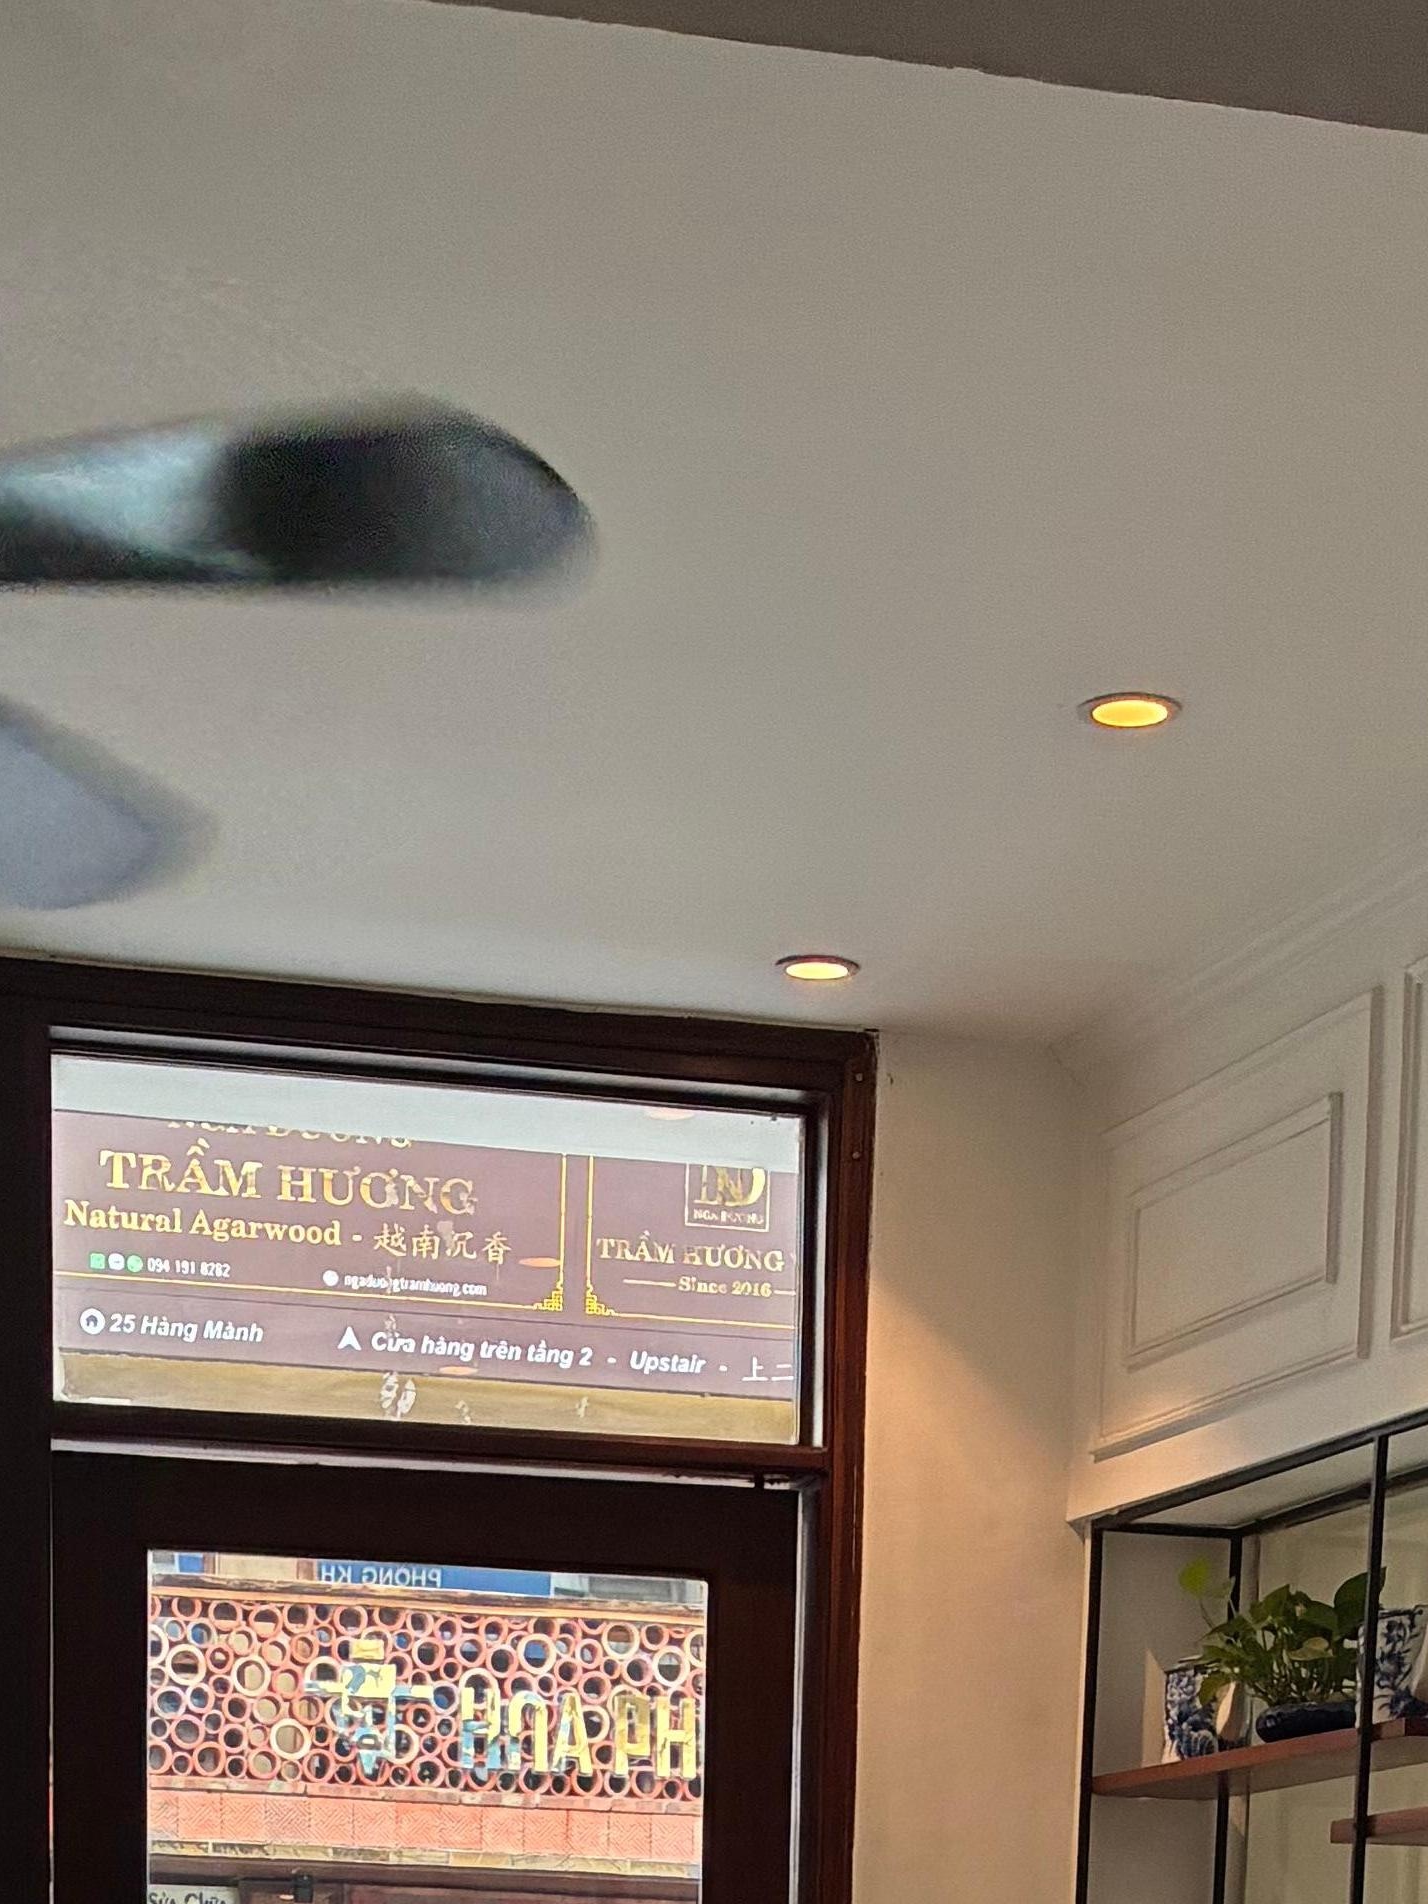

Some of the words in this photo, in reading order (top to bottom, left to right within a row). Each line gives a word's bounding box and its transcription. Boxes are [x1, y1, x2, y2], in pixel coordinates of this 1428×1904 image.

[99, 1137, 263, 1200] TRẦM
[277, 1164, 478, 1217] HƯƠNG
[63, 1199, 182, 1235] Natural
[189, 1209, 341, 1247] Agarwood
[596, 1231, 675, 1265] TRẦM
[678, 1276, 727, 1294] Since
[108, 1313, 136, 1335] 25
[140, 1313, 198, 1343] Hàng
[202, 1317, 264, 1344] Mành
[421, 1335, 474, 1361] hàng
[480, 1340, 521, 1361] trên
[527, 1339, 573, 1369] tầng
[579, 1347, 593, 1367] 2
[630, 1351, 706, 1376] Upstair
